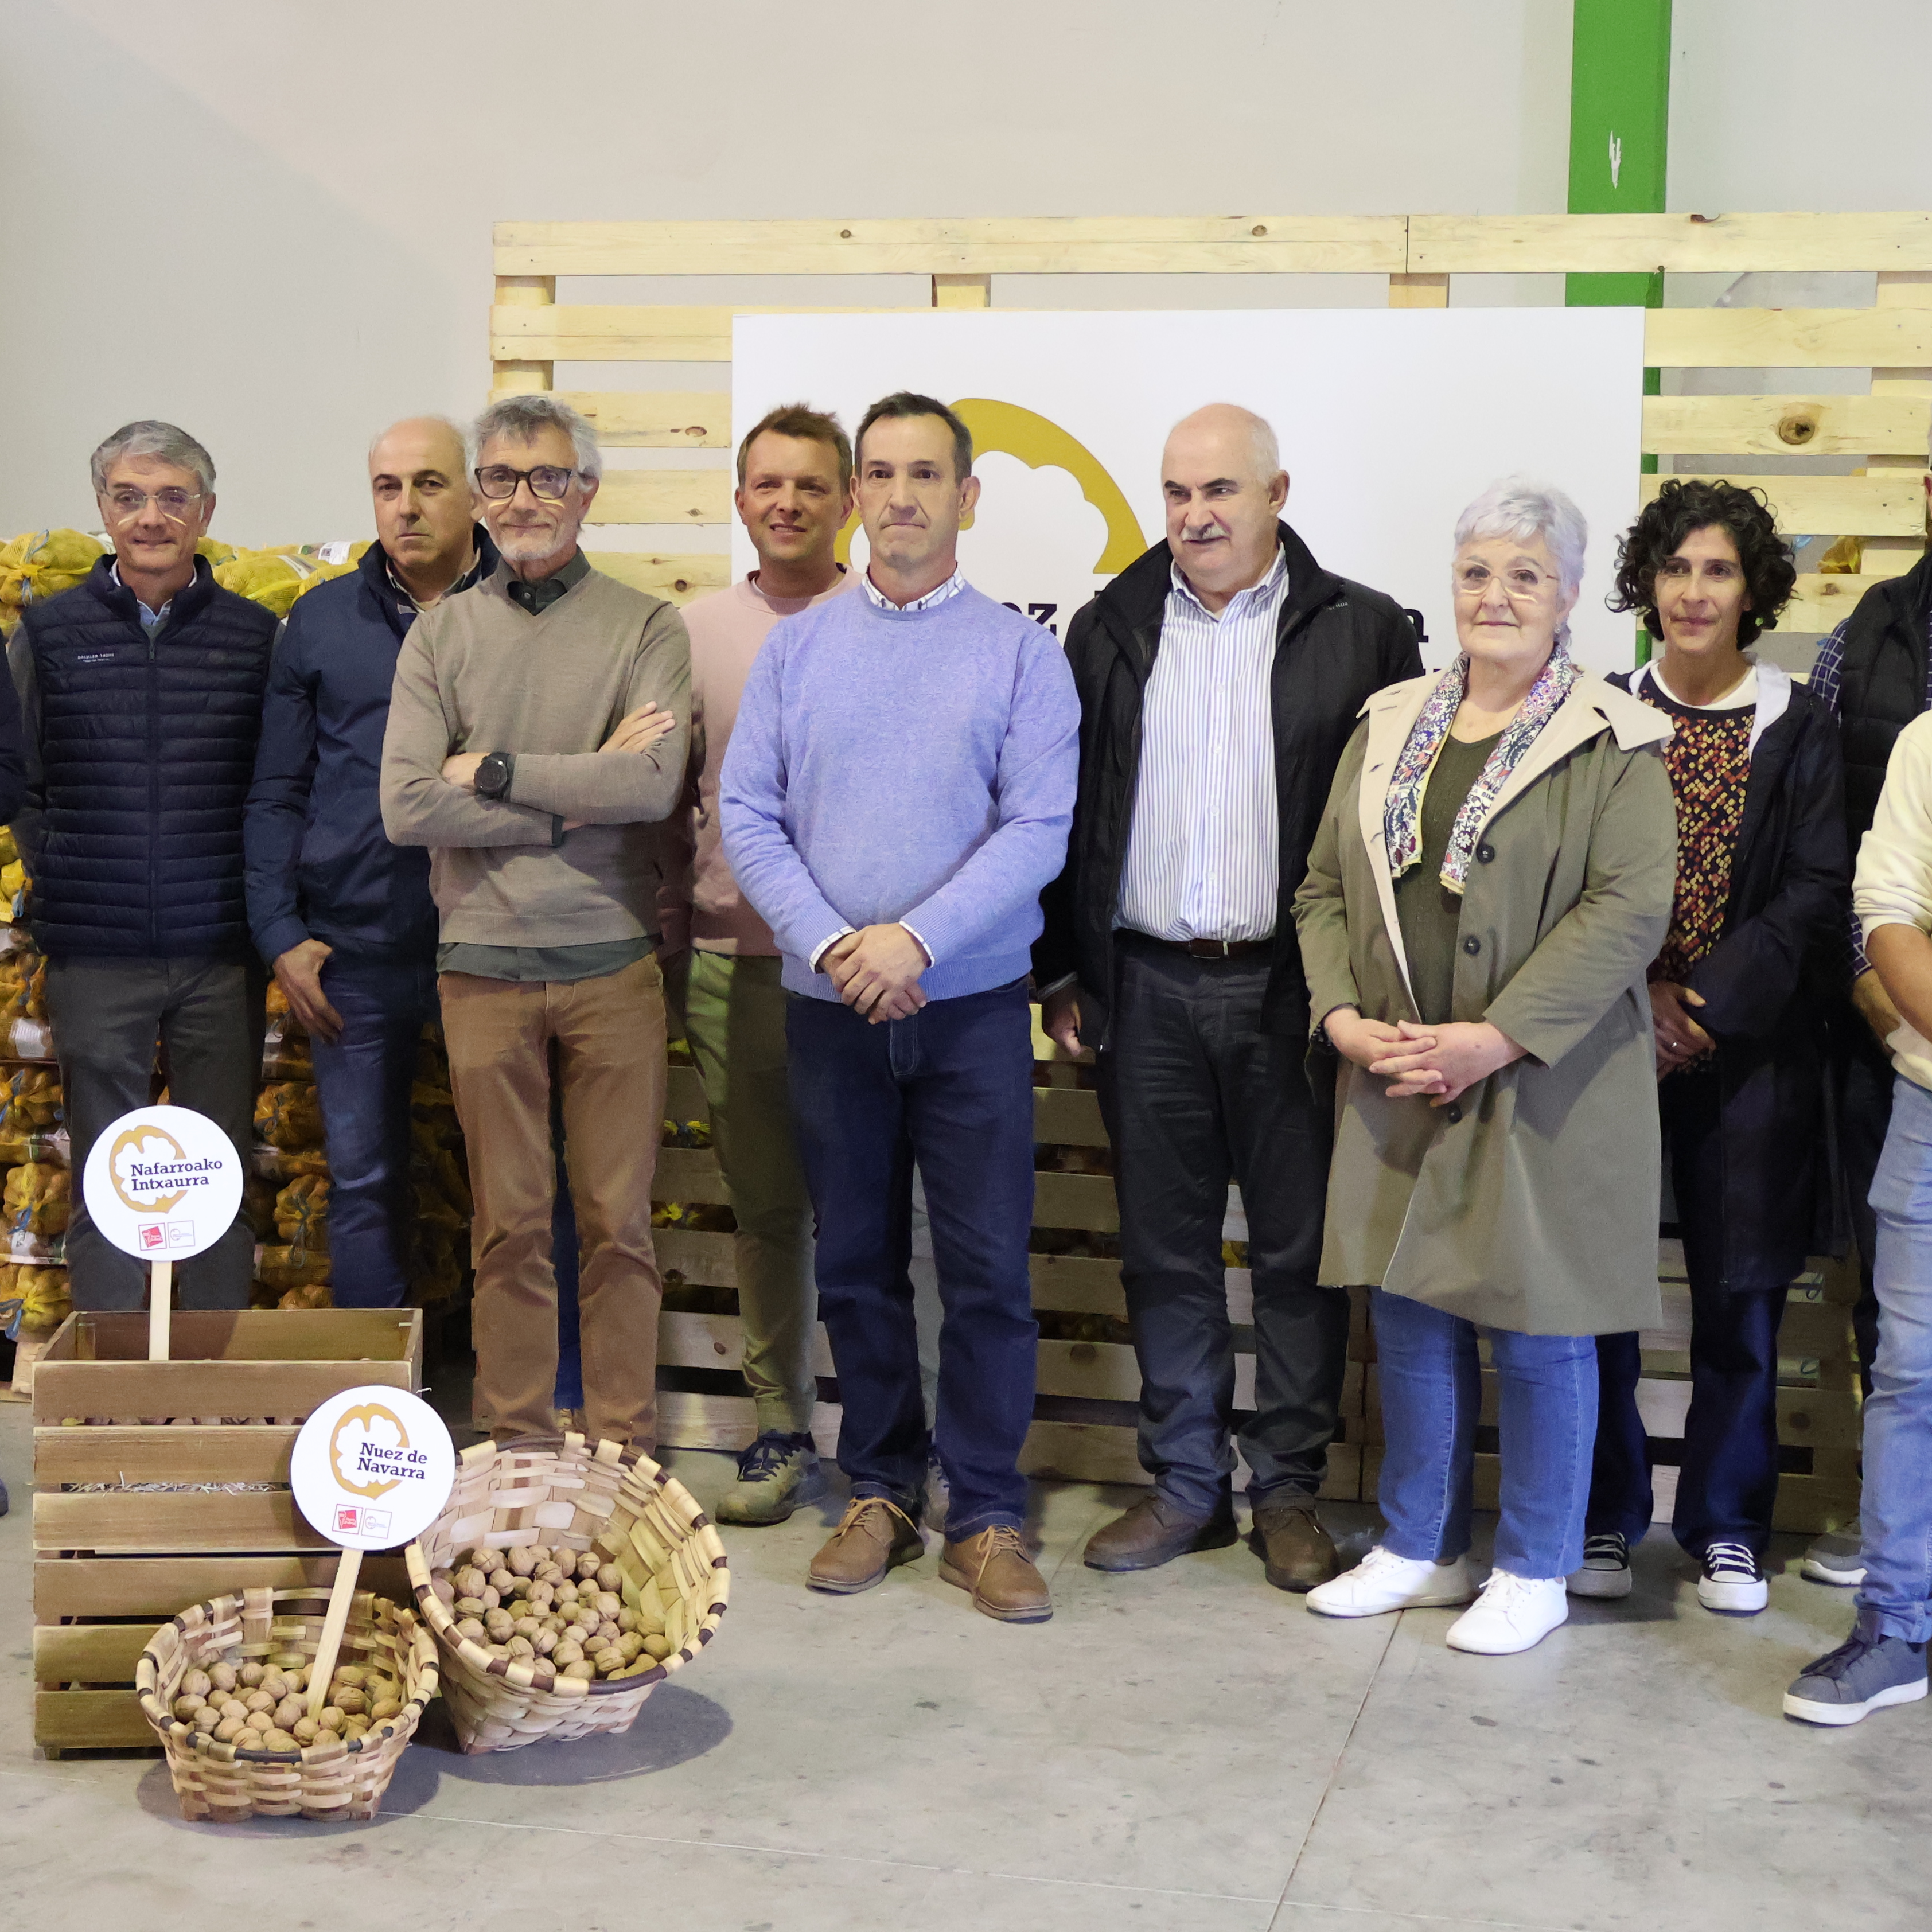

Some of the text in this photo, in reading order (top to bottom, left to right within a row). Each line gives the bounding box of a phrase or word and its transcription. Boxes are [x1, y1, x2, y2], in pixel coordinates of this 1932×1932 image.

[131, 1158, 223, 1177] Nafarroako
[131, 1176, 209, 1191] Intxaurra
[360, 1442, 427, 1464] Nuez de
[357, 1457, 425, 1479] Navarra
